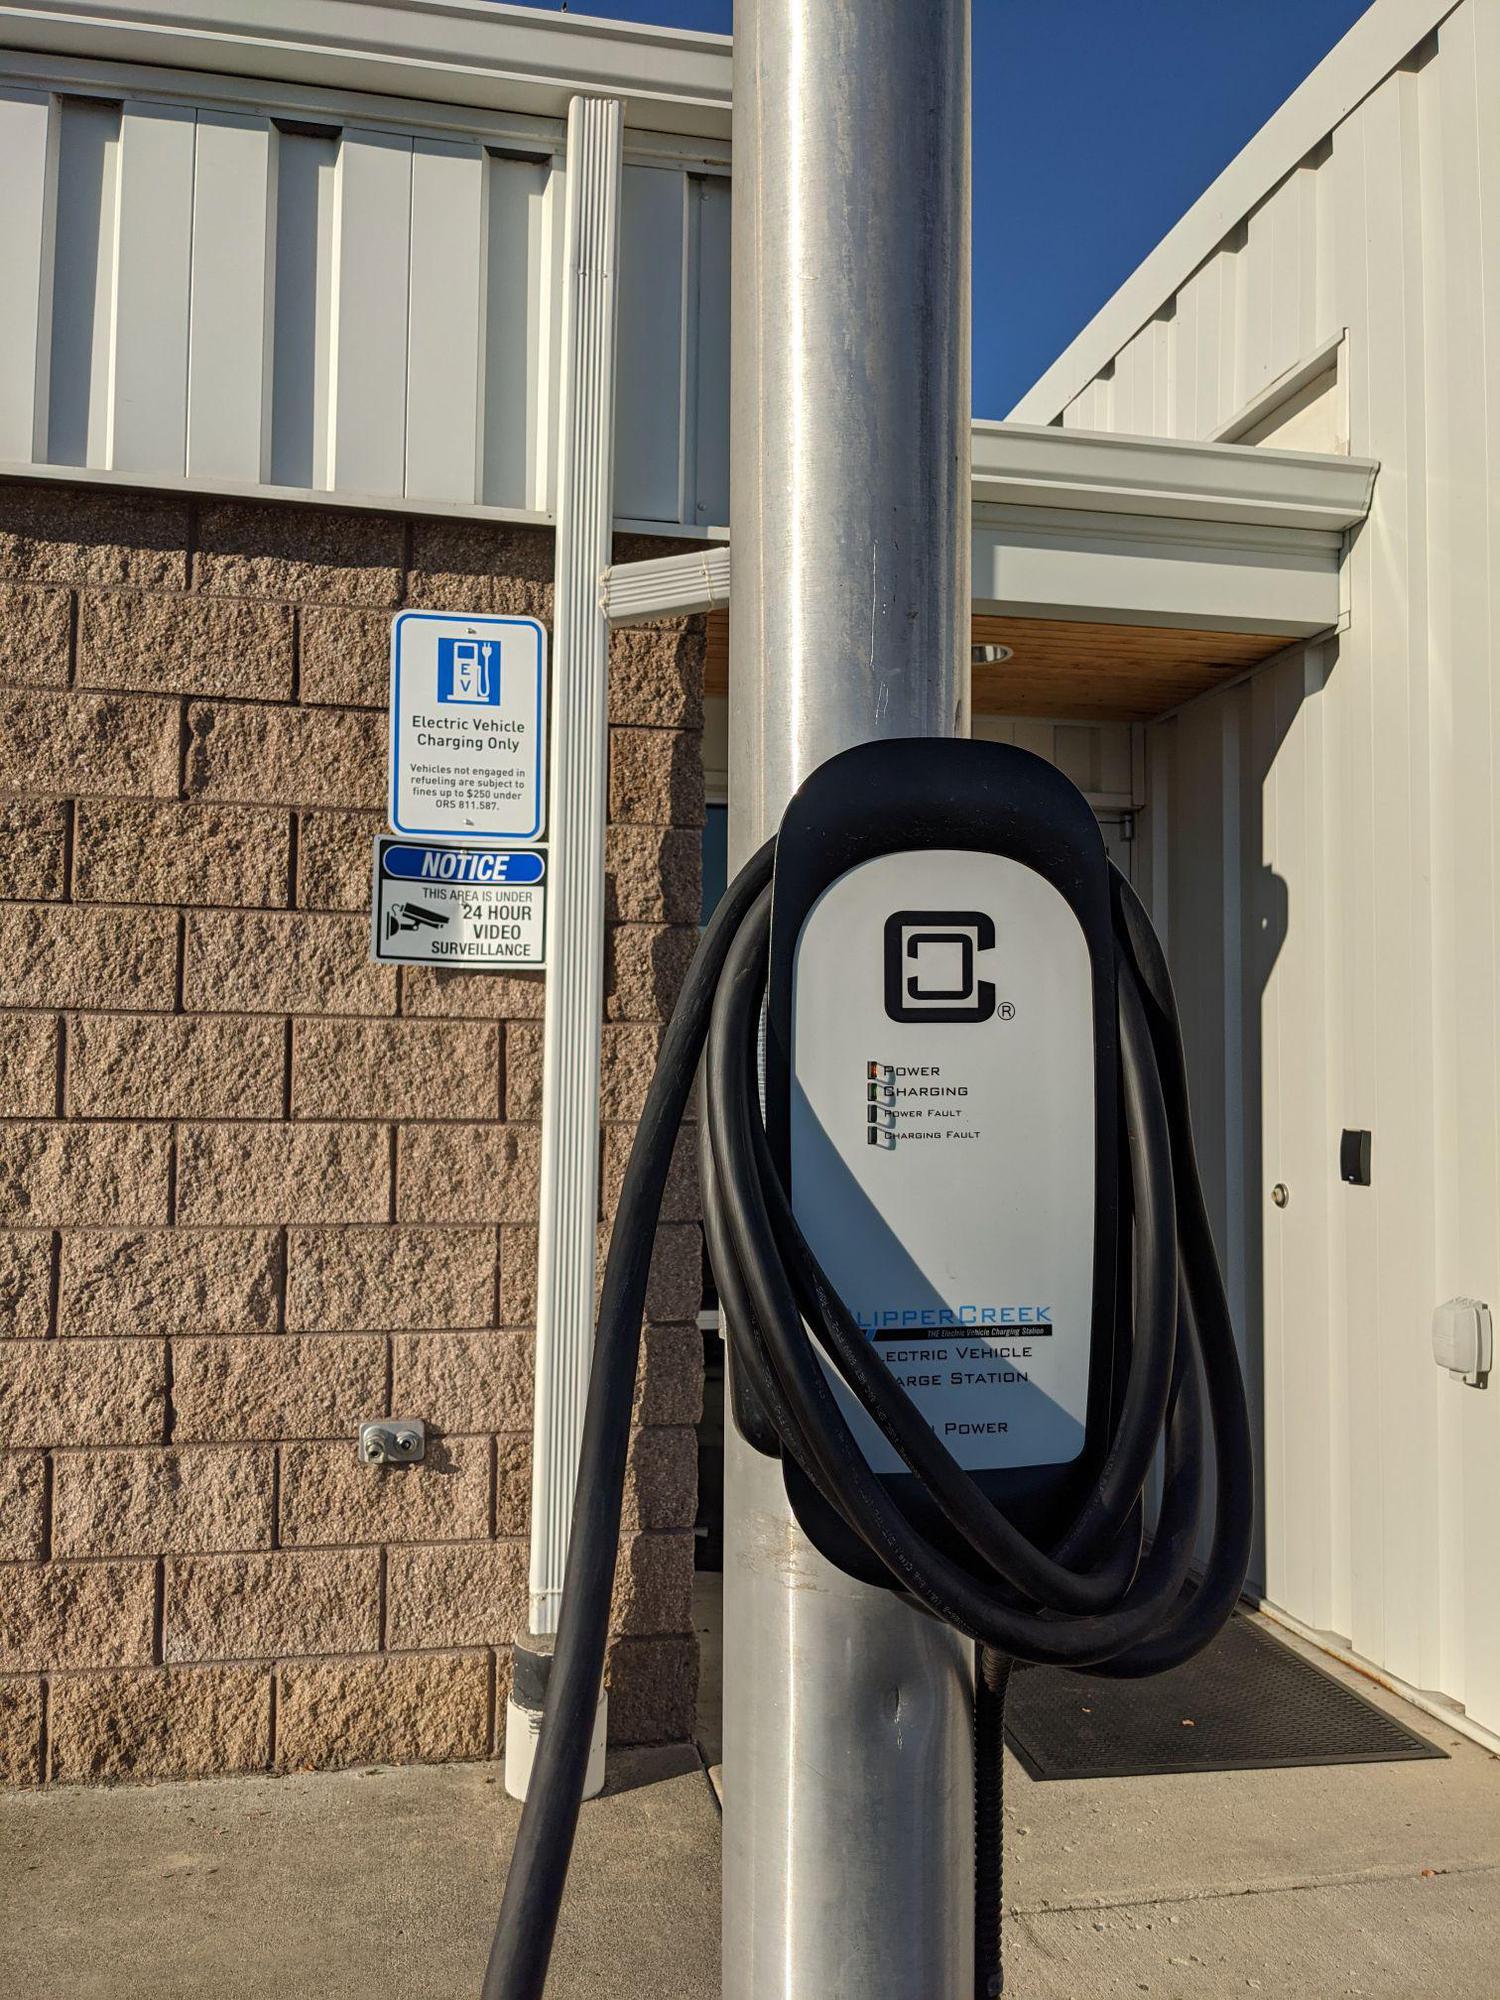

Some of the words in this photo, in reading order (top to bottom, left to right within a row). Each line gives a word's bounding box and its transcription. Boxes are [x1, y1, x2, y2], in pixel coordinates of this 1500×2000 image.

[412, 715, 469, 730] Electric
[473, 718, 525, 733] Vehicle
[417, 733, 483, 751] Charging
[487, 737, 520, 753] Only
[410, 763, 452, 774] Vehicles
[454, 767, 470, 775] not
[472, 768, 514, 778] engaged
[516, 769, 526, 777] in
[411, 776, 456, 787] refueling
[458, 779, 475, 787] are
[477, 779, 512, 790] subject
[515, 780, 525, 789] to
[412, 787, 437, 796] fines
[440, 790, 452, 799] up
[454, 789, 464, 797] to
[466, 788, 491, 799] $250
[493, 790, 522, 800] under
[435, 799, 456, 809] ORS
[458, 801, 500, 811] 811.587.
[421, 851, 510, 881] NOTICE
[422, 887, 447, 900] THIS
[449, 889, 479, 902] AREA
[482, 891, 493, 902] IS
[496, 891, 533, 903] UNDER
[463, 905, 483, 920] 24
[488, 905, 532, 921] HOUR
[473, 924, 522, 940] VIDEO
[431, 940, 531, 956] SURVEILLANCE
[884, 1065, 940, 1076] POWER
[883, 1085, 968, 1097] CHARGING
[884, 1109, 922, 1118] POWER
[927, 1109, 962, 1117] FAULT
[884, 1131, 941, 1140] CHARGING
[946, 1130, 981, 1139] FAULT
[856, 1305, 1051, 1328] LIPPERCREEK
[928, 1330, 940, 1338] THE
[942, 1329, 966, 1337] Electric
[967, 1327, 990, 1336] Vehicle
[991, 1327, 1020, 1337] Charging
[1022, 1326, 1045, 1335] Station
[876, 1349, 948, 1362] ECTRIC
[956, 1346, 1033, 1360] VEHICLE
[895, 1374, 941, 1387] ARGE
[951, 1371, 1029, 1385] STATION
[944, 1422, 1009, 1436] POWER
